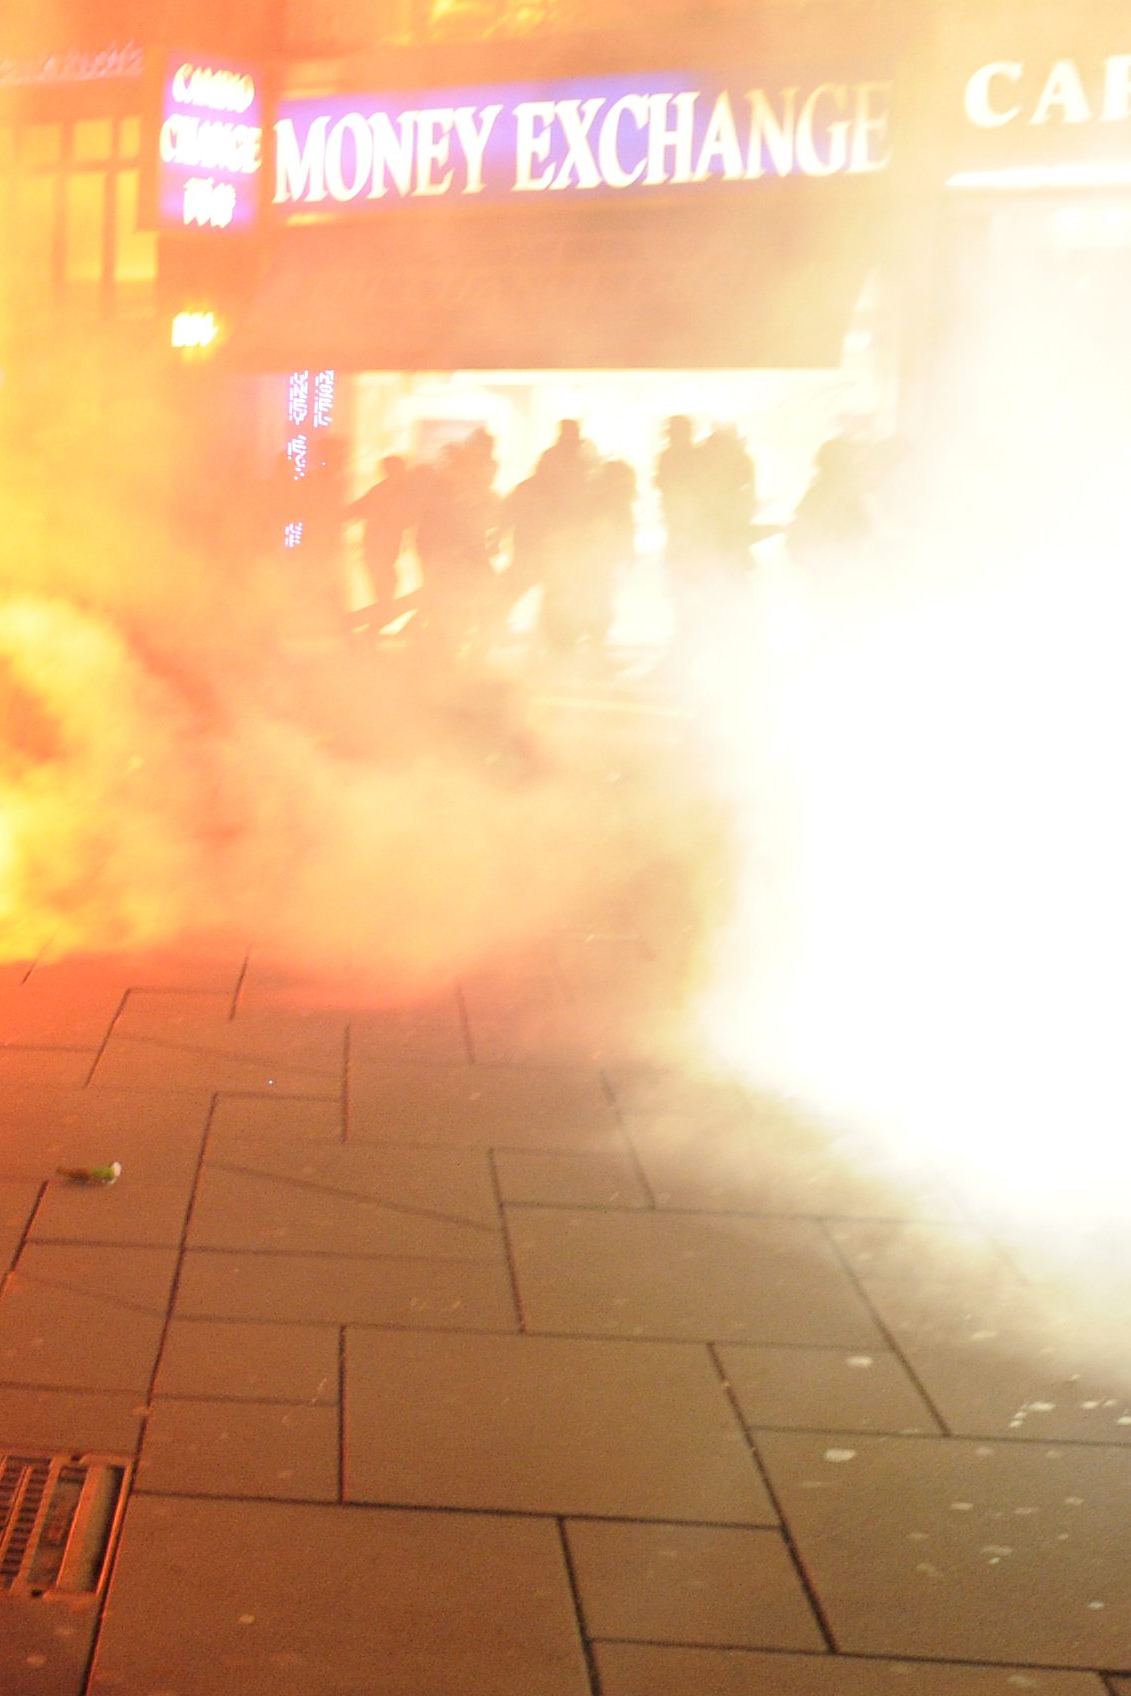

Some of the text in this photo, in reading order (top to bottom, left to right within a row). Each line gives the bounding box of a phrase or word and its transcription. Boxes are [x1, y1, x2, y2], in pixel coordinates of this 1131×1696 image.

[160, 113, 262, 173] CHANGE
[272, 104, 503, 203] MONEY
[511, 79, 894, 191] EXCHANGE
